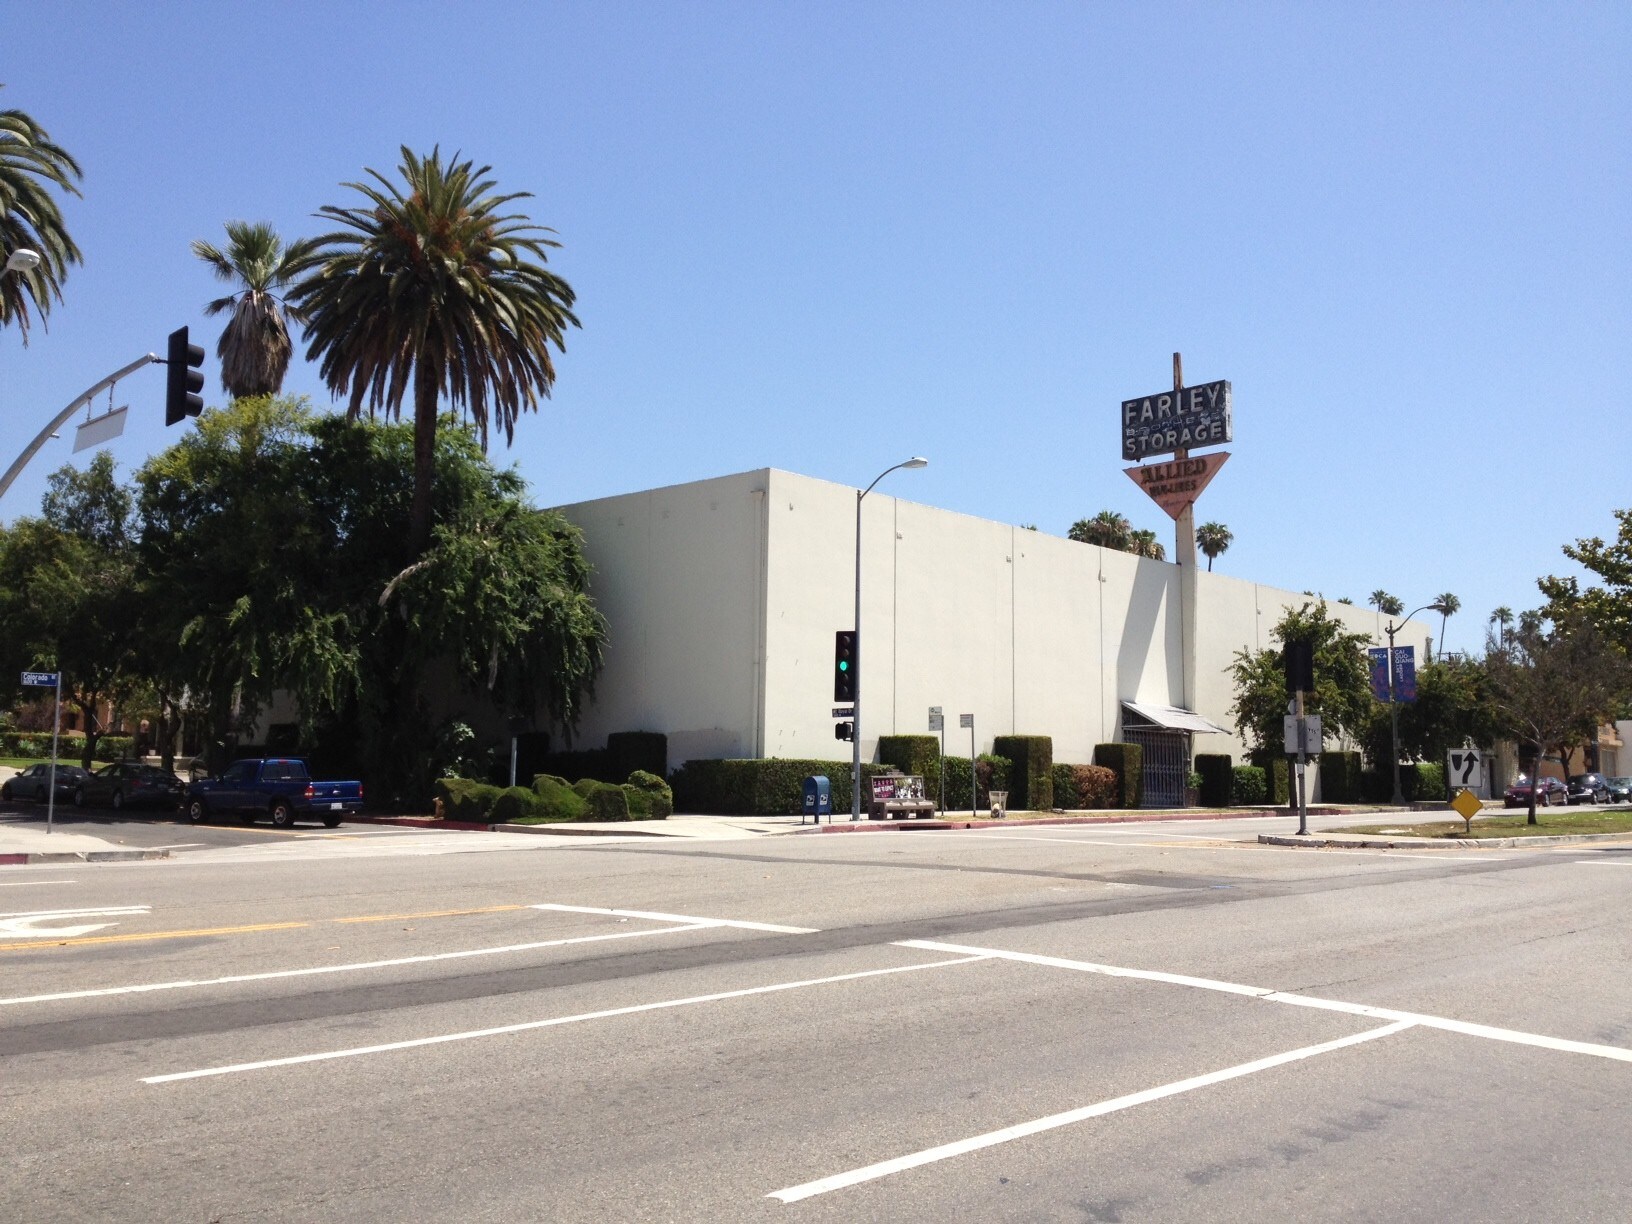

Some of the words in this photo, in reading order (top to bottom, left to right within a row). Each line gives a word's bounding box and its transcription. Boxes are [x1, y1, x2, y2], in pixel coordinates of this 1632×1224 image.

[1125, 383, 1220, 425] FARLEY
[1126, 421, 1222, 453] STORAGE
[1140, 458, 1208, 484] ALLIED
